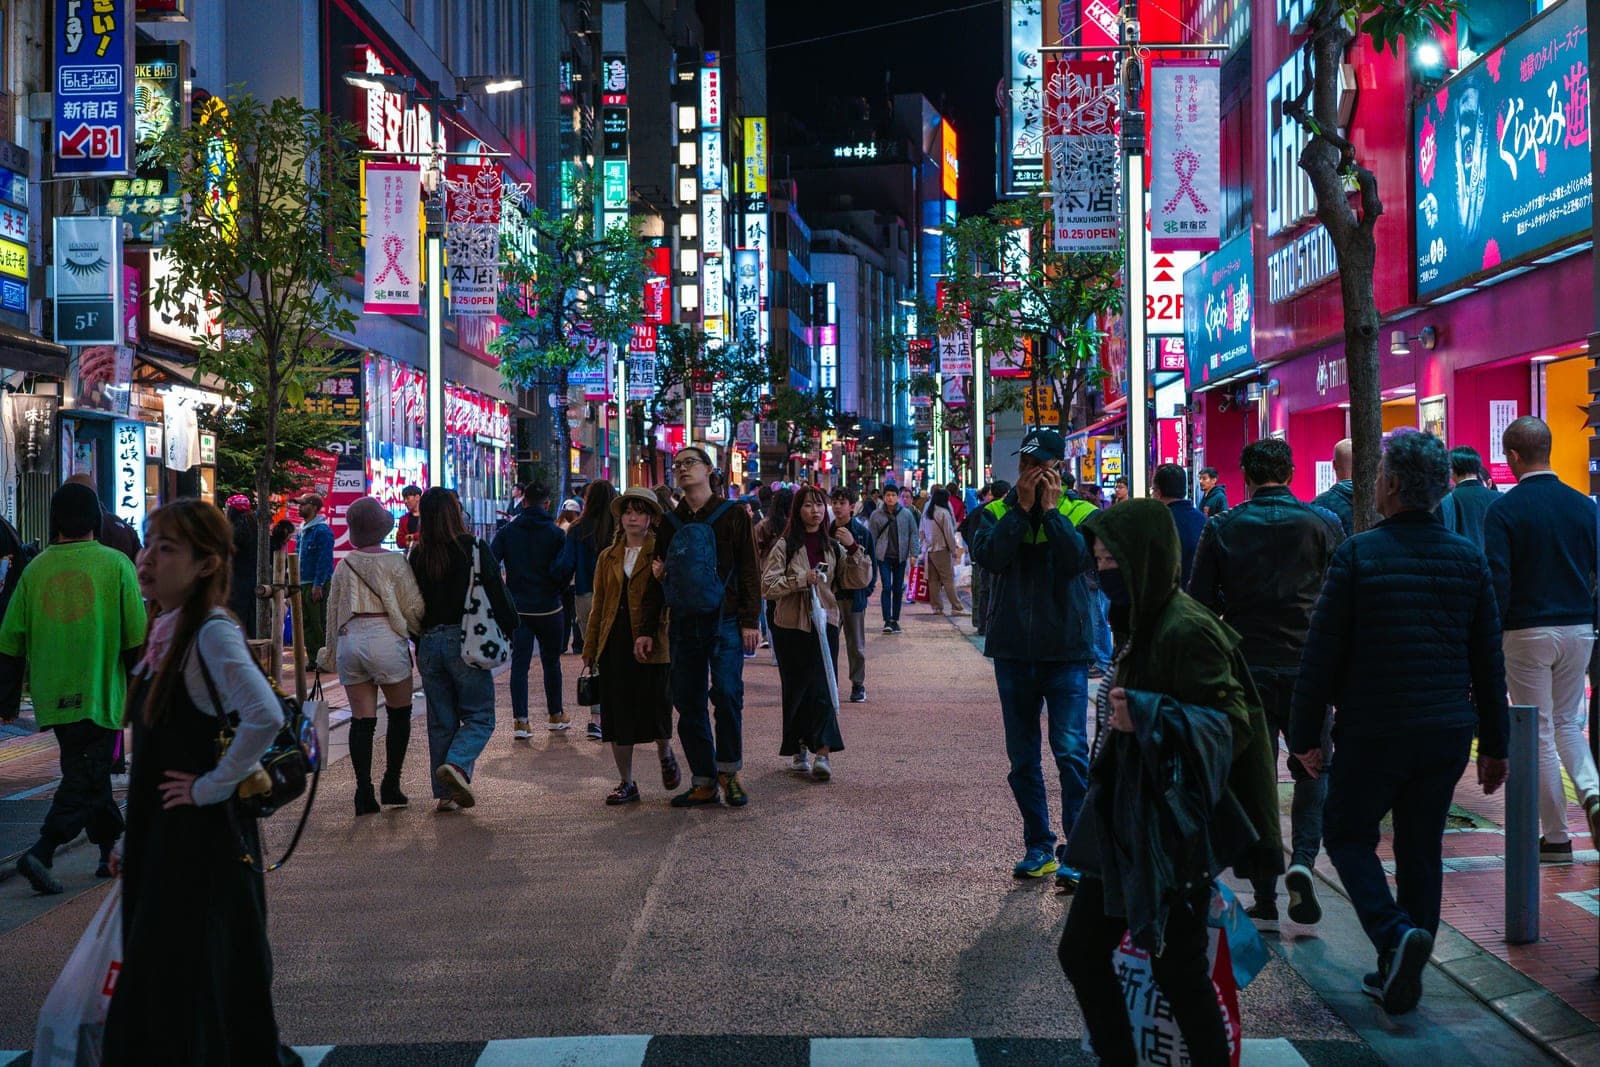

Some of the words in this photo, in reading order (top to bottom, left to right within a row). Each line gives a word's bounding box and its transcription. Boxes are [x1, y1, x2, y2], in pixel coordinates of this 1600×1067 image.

[154, 65, 172, 77] BAR
[1188, 74, 1198, 122] 乳がん検診
[63, 101, 118, 119] 新宿店
[1499, 61, 1591, 181] くらやみ遊
[91, 126, 120, 157] B1
[1058, 187, 1113, 213] 本店
[748, 202, 765, 211] 4F
[1058, 216, 1088, 224] SNJUKU
[1088, 215, 1115, 223] HONTEN
[1179, 220, 1208, 230] 新宿区
[1058, 229, 1083, 239] 10.25
[1087, 228, 1116, 239] OPEN
[452, 265, 494, 284] 本店
[1267, 242, 1296, 304] TAITO
[387, 290, 409, 298] 新宿区
[451, 297, 469, 305] 0.25
[471, 297, 494, 305] OPEN
[74, 311, 99, 330] 5F
[630, 338, 653, 349] QLO
[942, 343, 970, 356] 本店
[630, 358, 653, 370] 新宿
[630, 372, 653, 384] 本店
[287, 397, 360, 415] キホーテ
